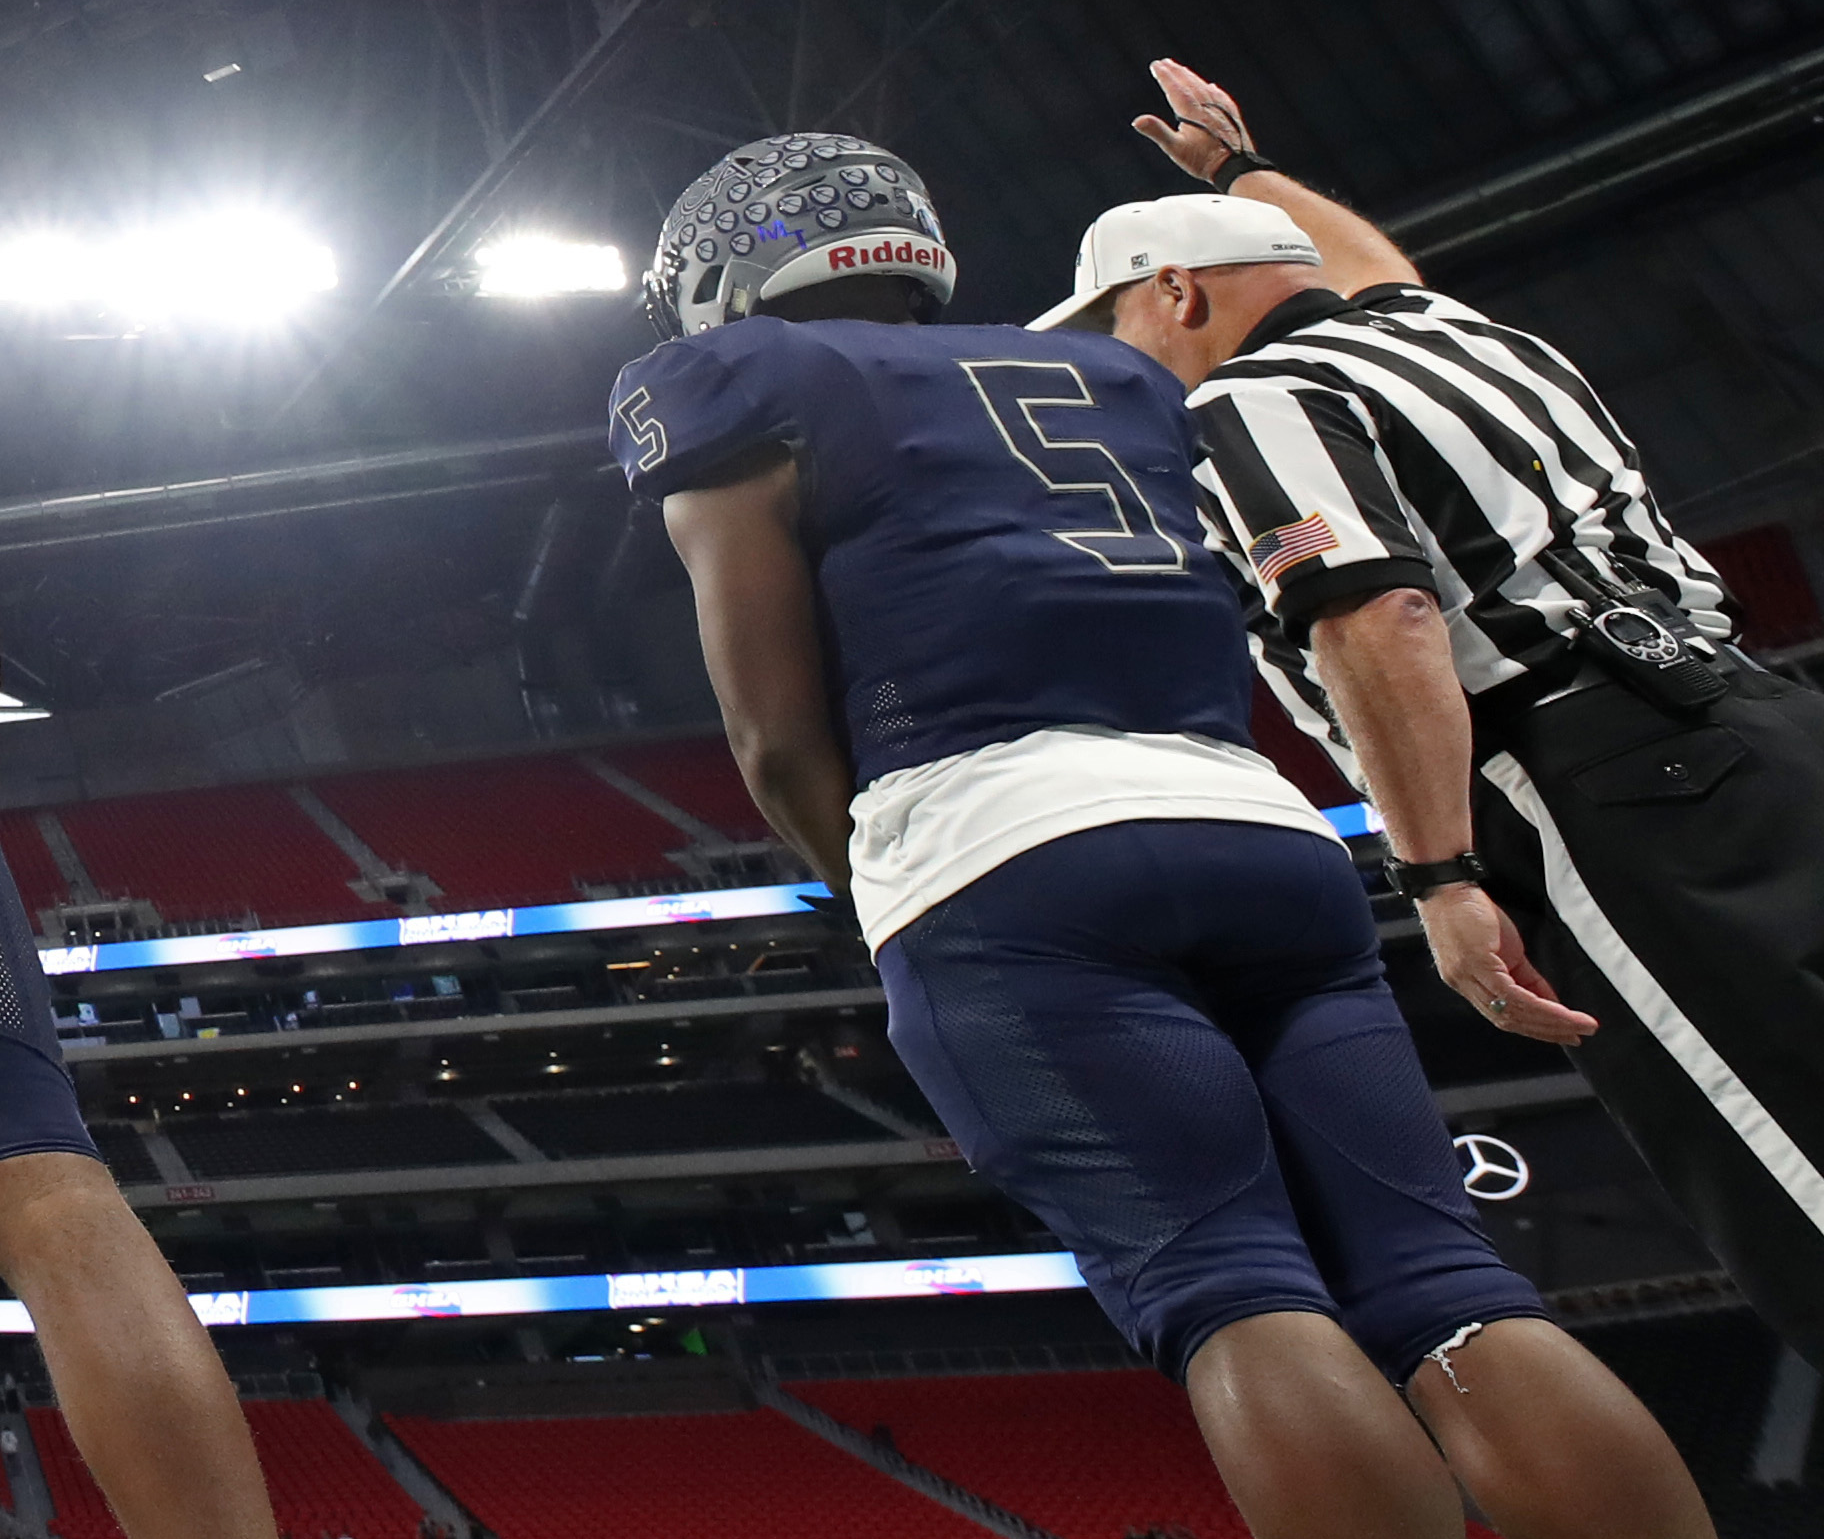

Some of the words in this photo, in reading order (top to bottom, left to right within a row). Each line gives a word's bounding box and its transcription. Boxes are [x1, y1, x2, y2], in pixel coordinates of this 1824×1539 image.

[827, 239, 947, 273] Riddell
[617, 385, 669, 473] 5
[958, 357, 1190, 576] 5
